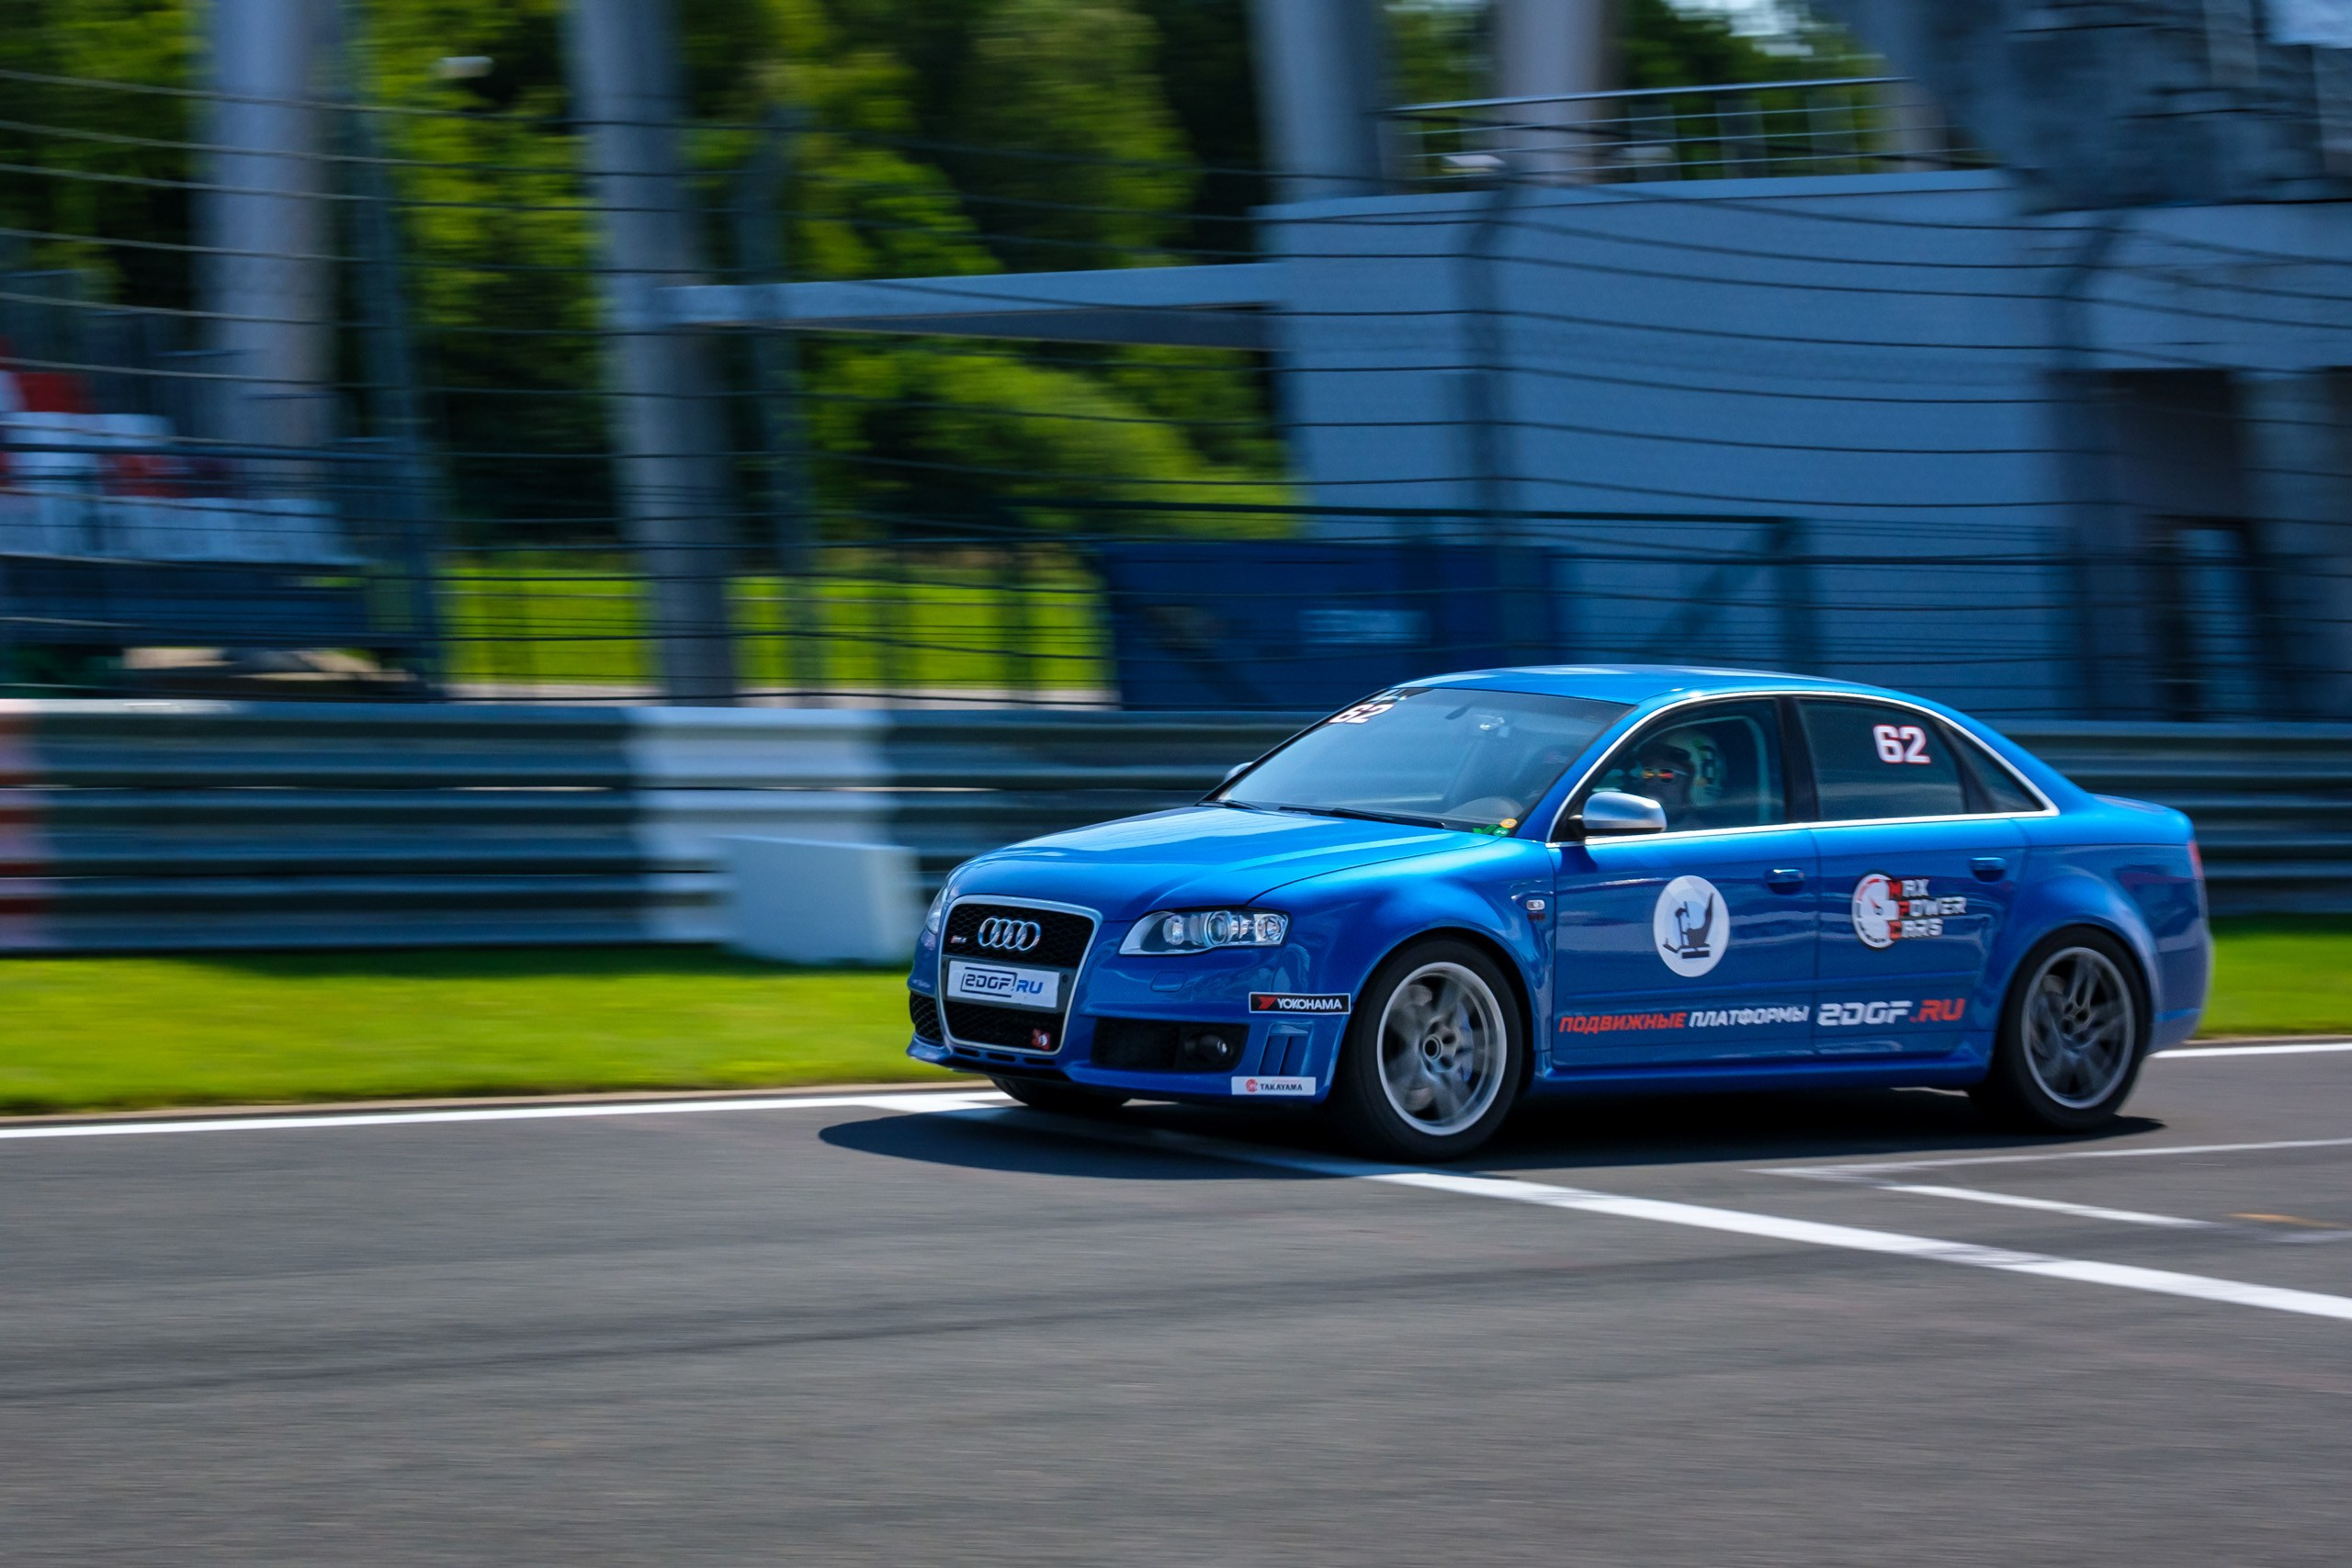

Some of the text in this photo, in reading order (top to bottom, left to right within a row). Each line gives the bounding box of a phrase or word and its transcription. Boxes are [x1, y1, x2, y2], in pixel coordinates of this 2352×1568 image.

[1328, 704, 1395, 724] 62
[1873, 724, 1931, 764] 62
[1898, 897, 1967, 917] POWER
[1277, 998, 1342, 1010] YOKOHAMA
[1559, 1006, 1810, 1034] ПОДВИЖНЫЕ ПЛАТФОРМЫ
[1260, 1083, 1303, 1091] TAKAYAMA
